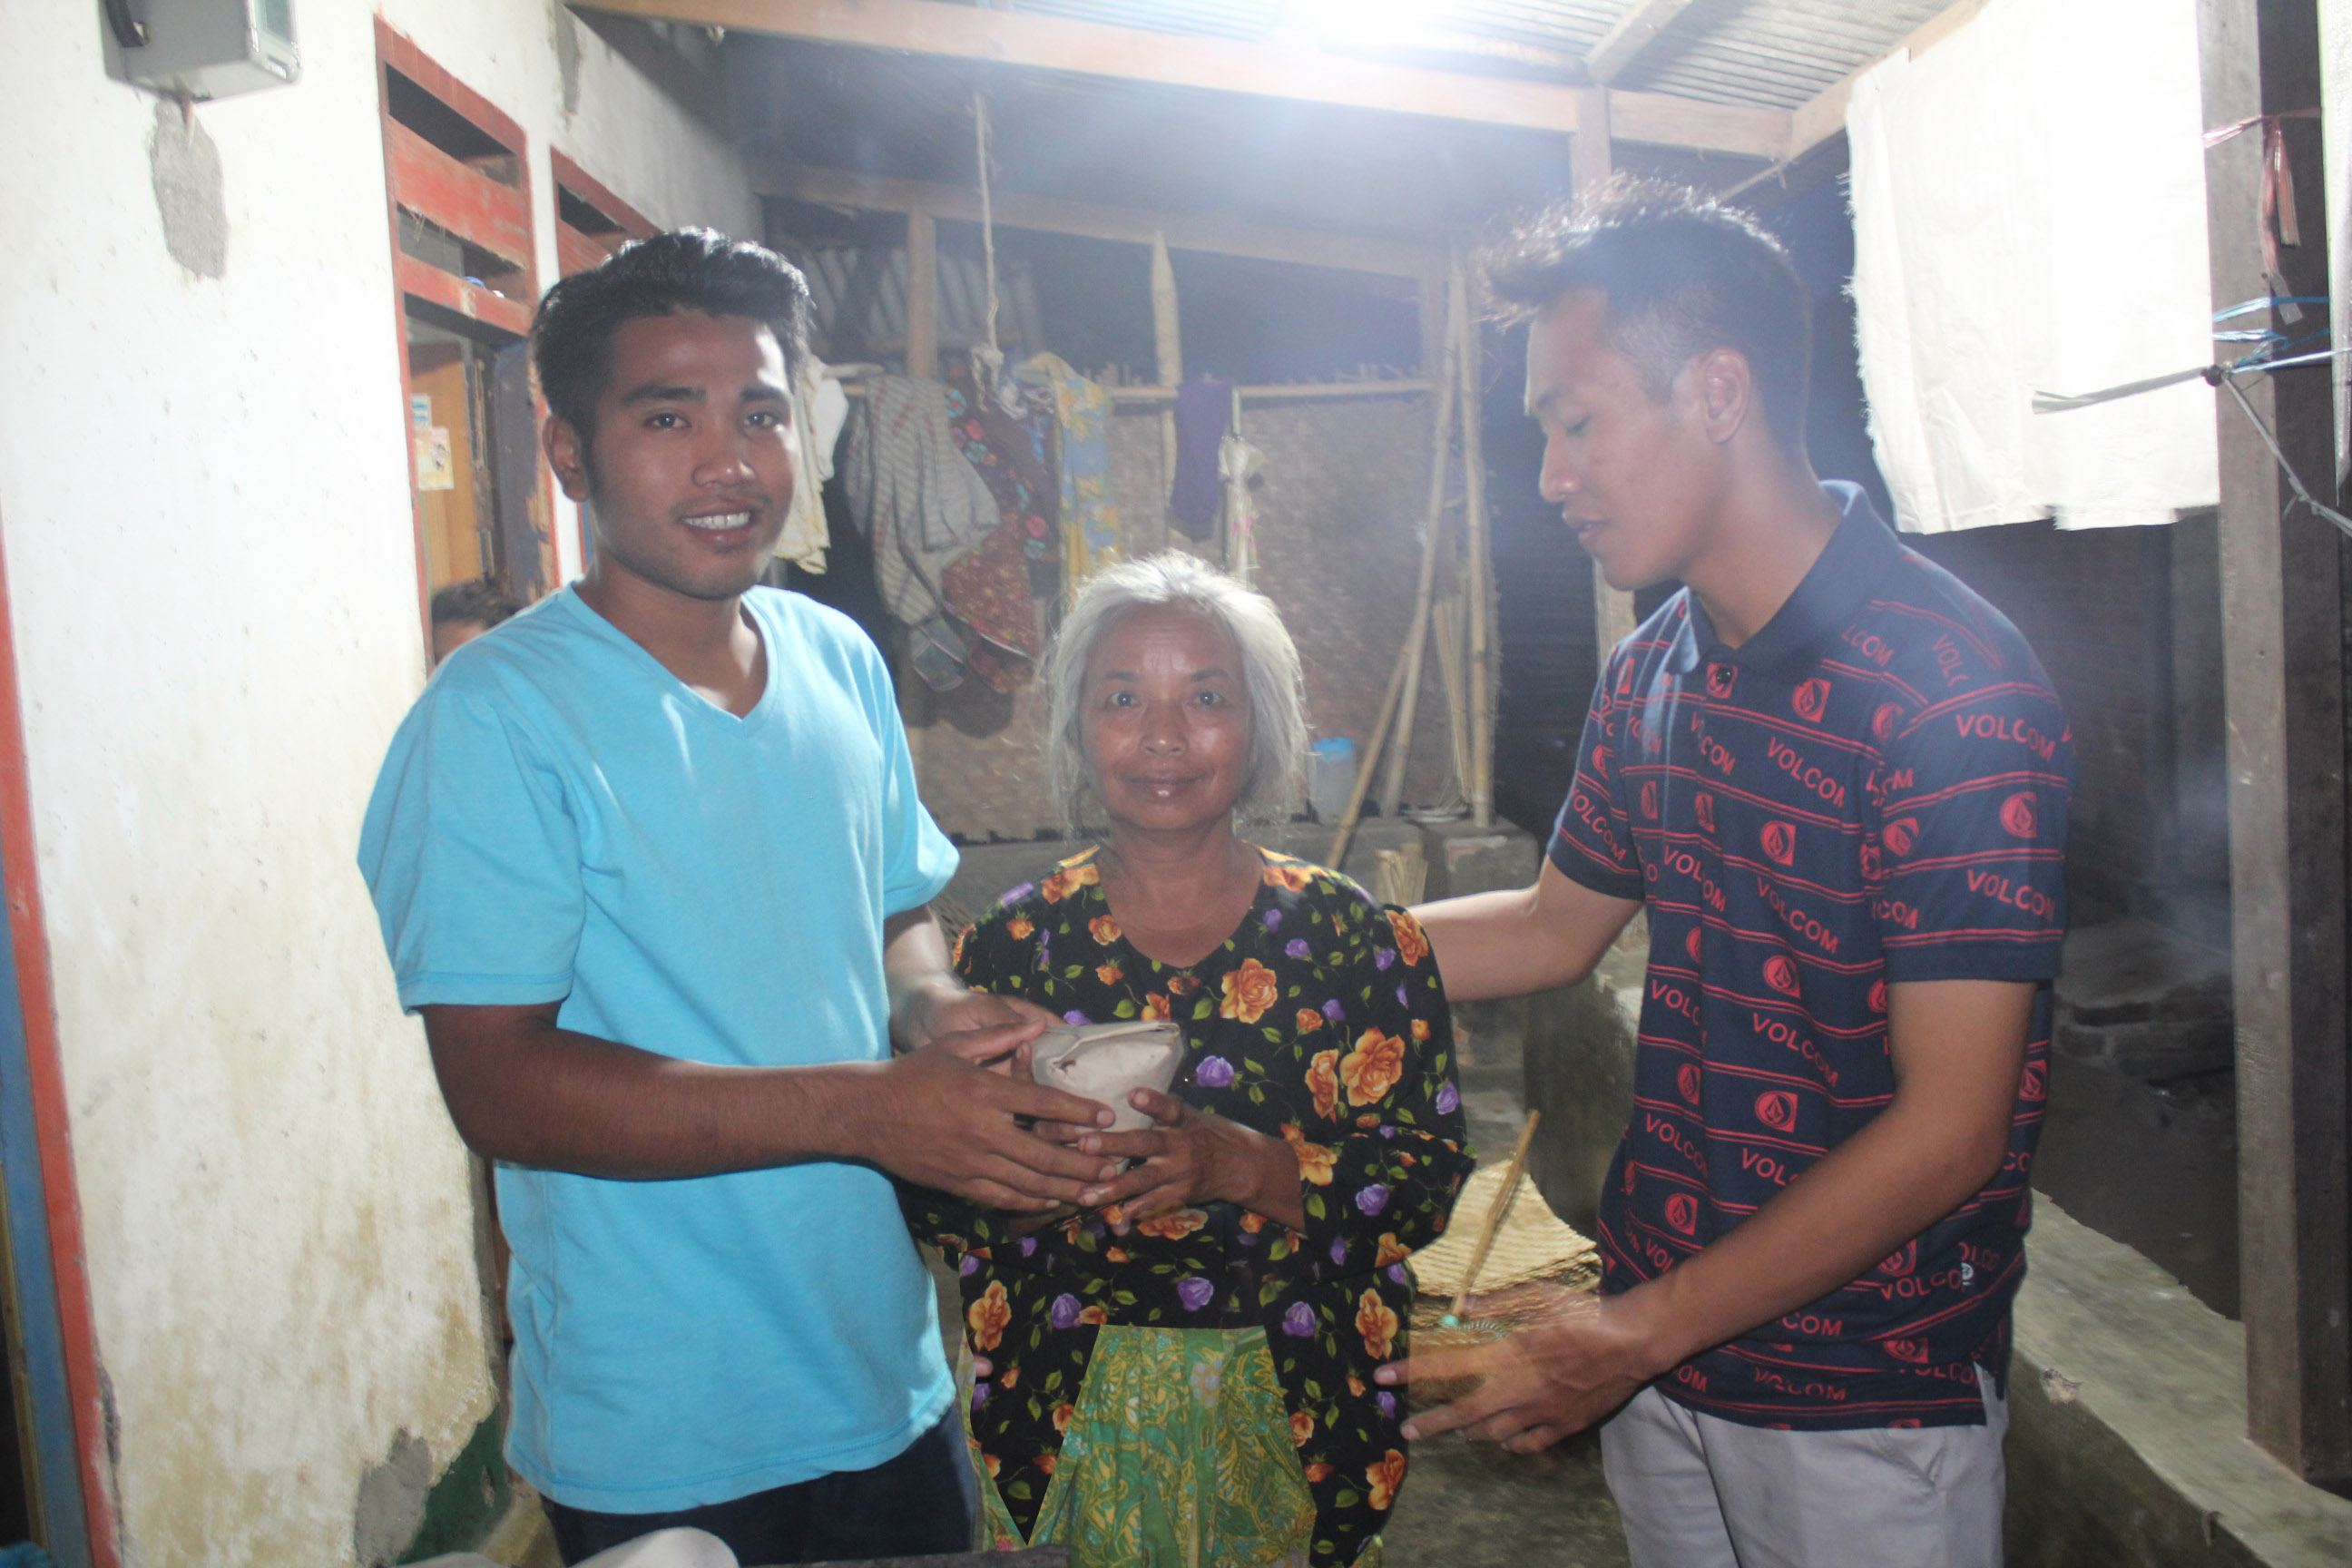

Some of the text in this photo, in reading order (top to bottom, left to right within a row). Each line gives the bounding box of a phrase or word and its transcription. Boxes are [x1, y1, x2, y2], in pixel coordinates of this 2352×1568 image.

[1956, 714, 2056, 761] VOLCOM
[1757, 877, 1839, 954] VOLCOM
[1753, 1012, 1839, 1088] VOLCOM
